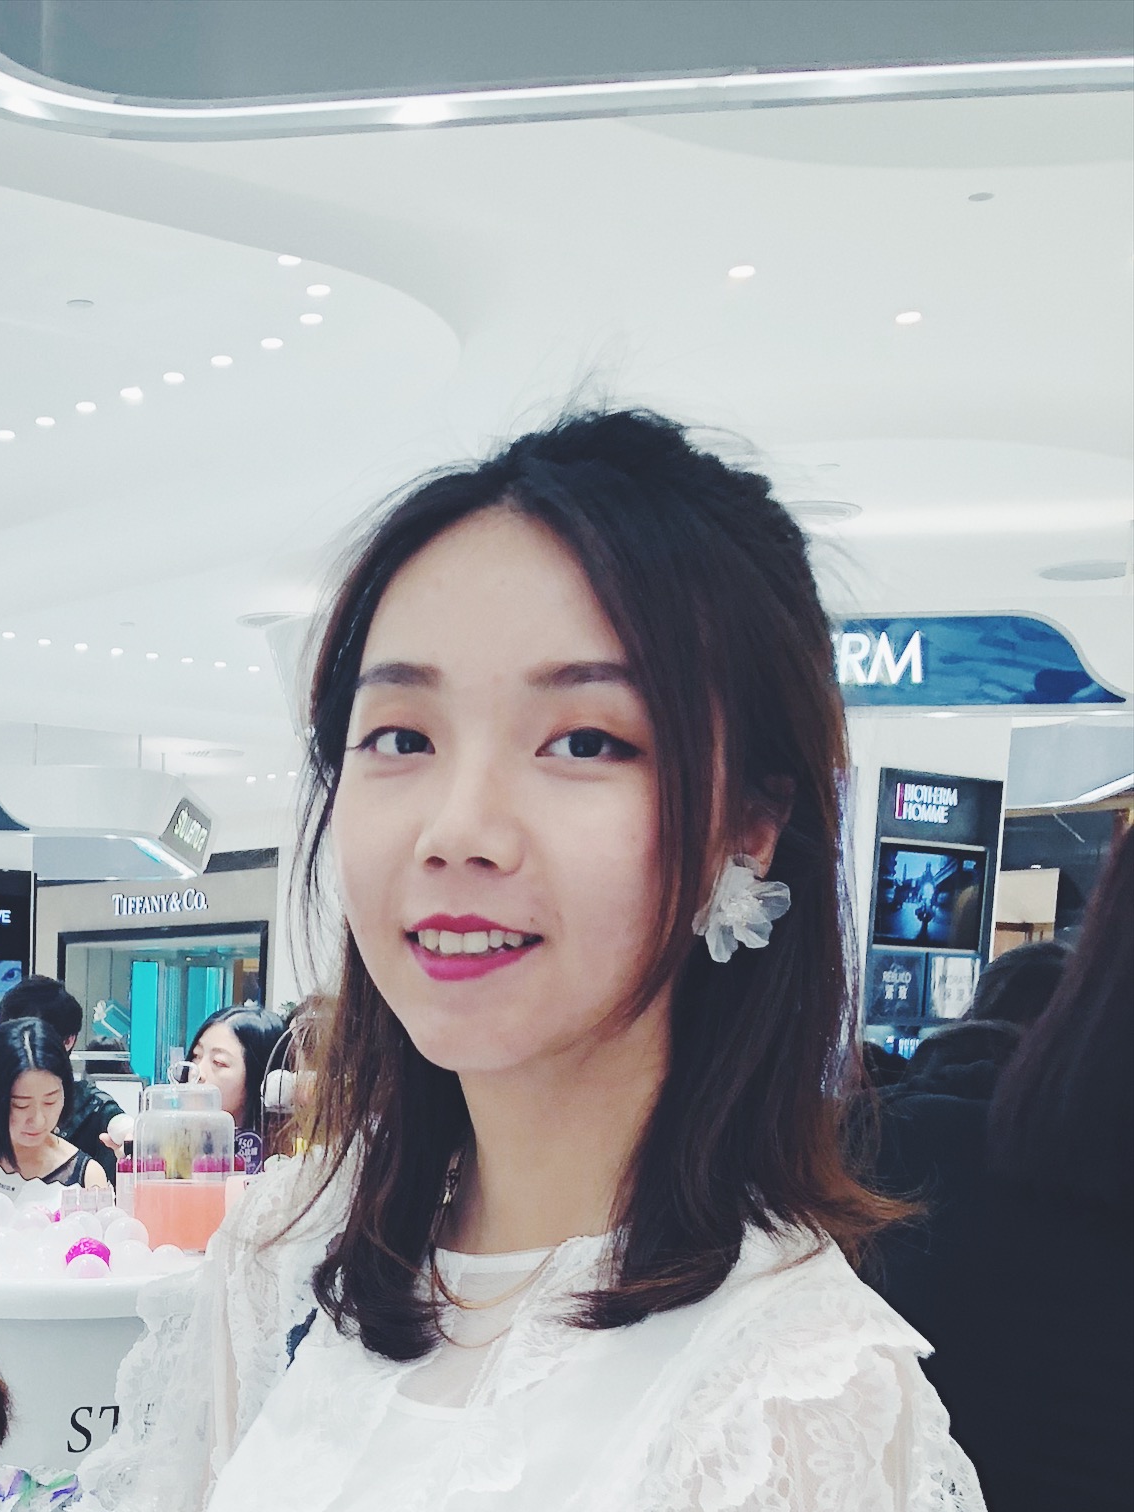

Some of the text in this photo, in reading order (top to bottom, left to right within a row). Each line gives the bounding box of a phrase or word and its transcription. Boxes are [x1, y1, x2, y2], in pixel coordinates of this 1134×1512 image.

[831, 630, 923, 685] RM
[903, 783, 959, 807] BIOTHERM
[902, 801, 950, 824] HOMME
